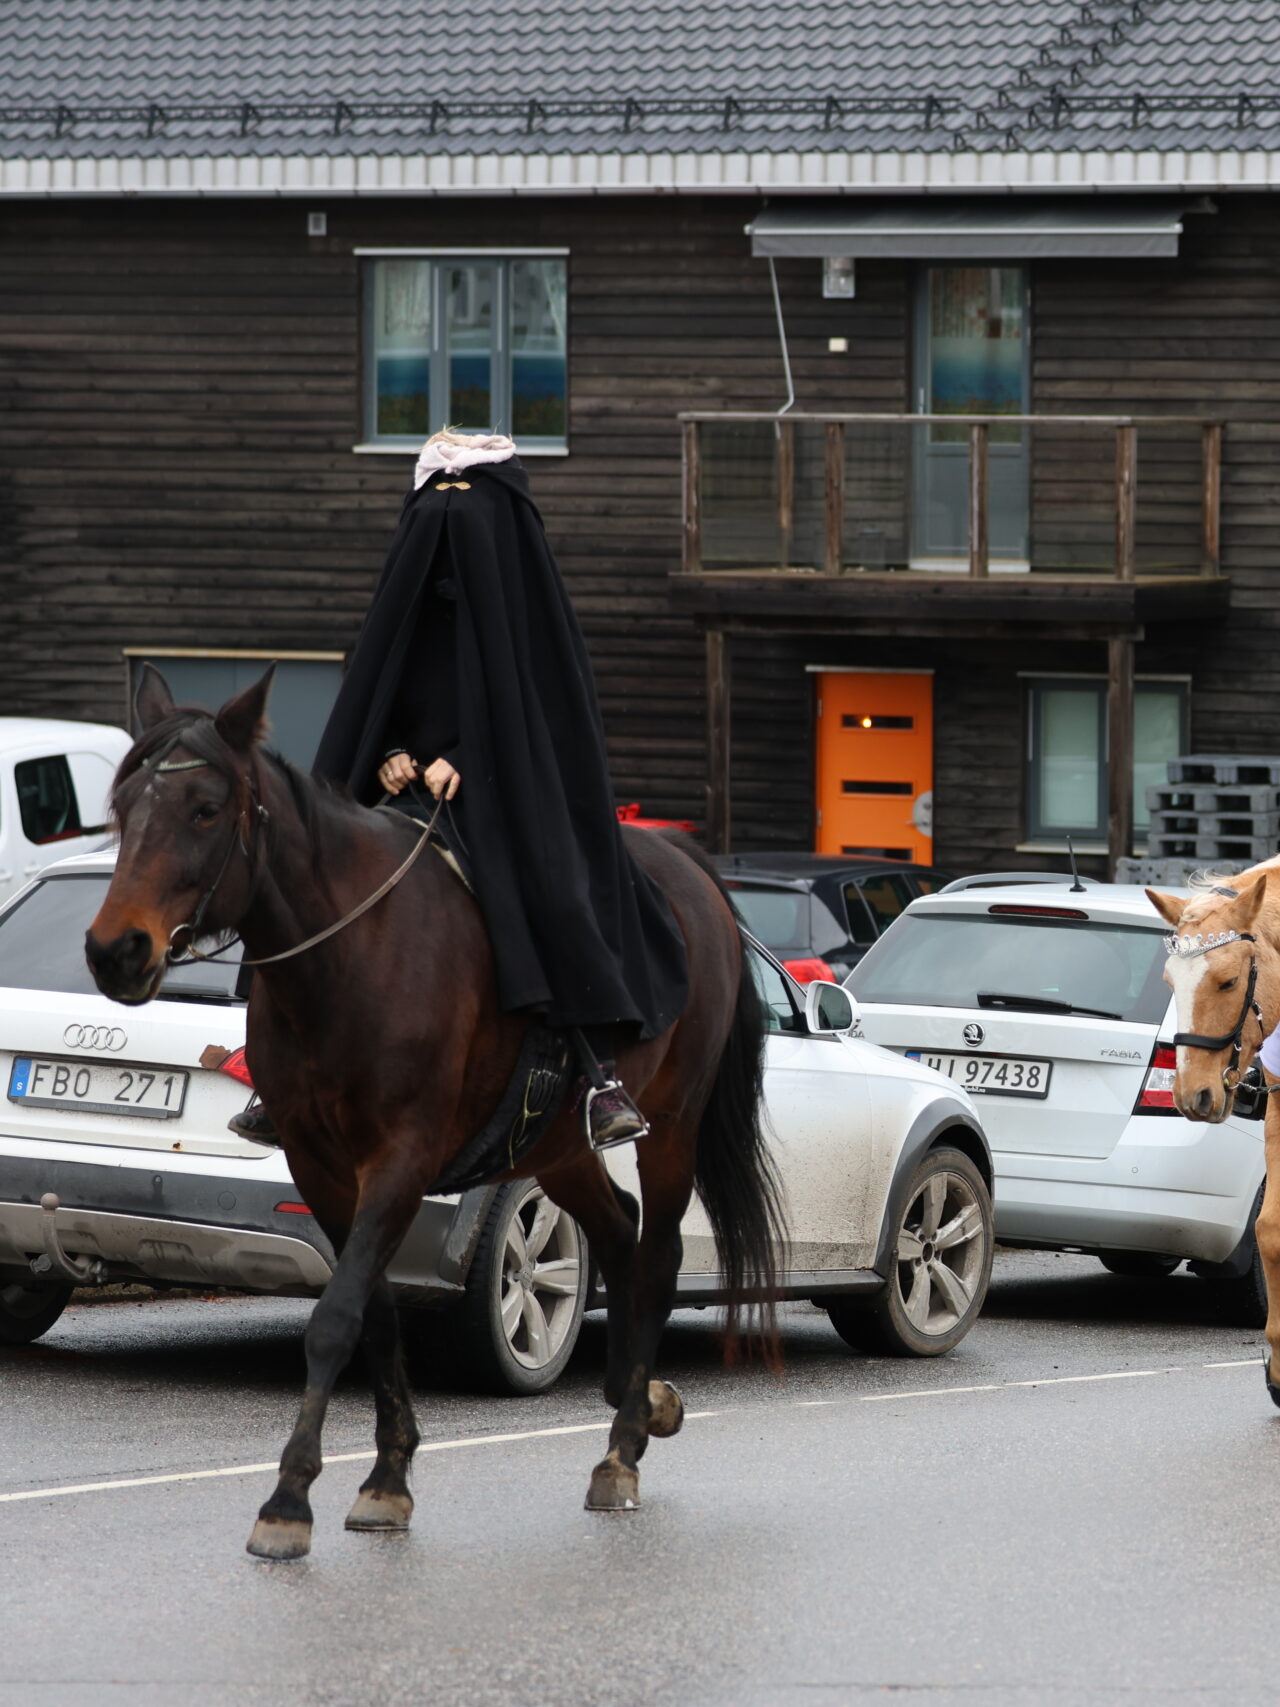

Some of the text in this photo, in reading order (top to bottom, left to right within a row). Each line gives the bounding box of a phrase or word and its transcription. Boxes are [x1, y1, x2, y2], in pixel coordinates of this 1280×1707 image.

[1100, 1048, 1142, 1059] FABIA
[965, 1060, 1041, 1088] 97438
[16, 1081, 23, 1091] S
[30, 1064, 175, 1107] FBO 271
